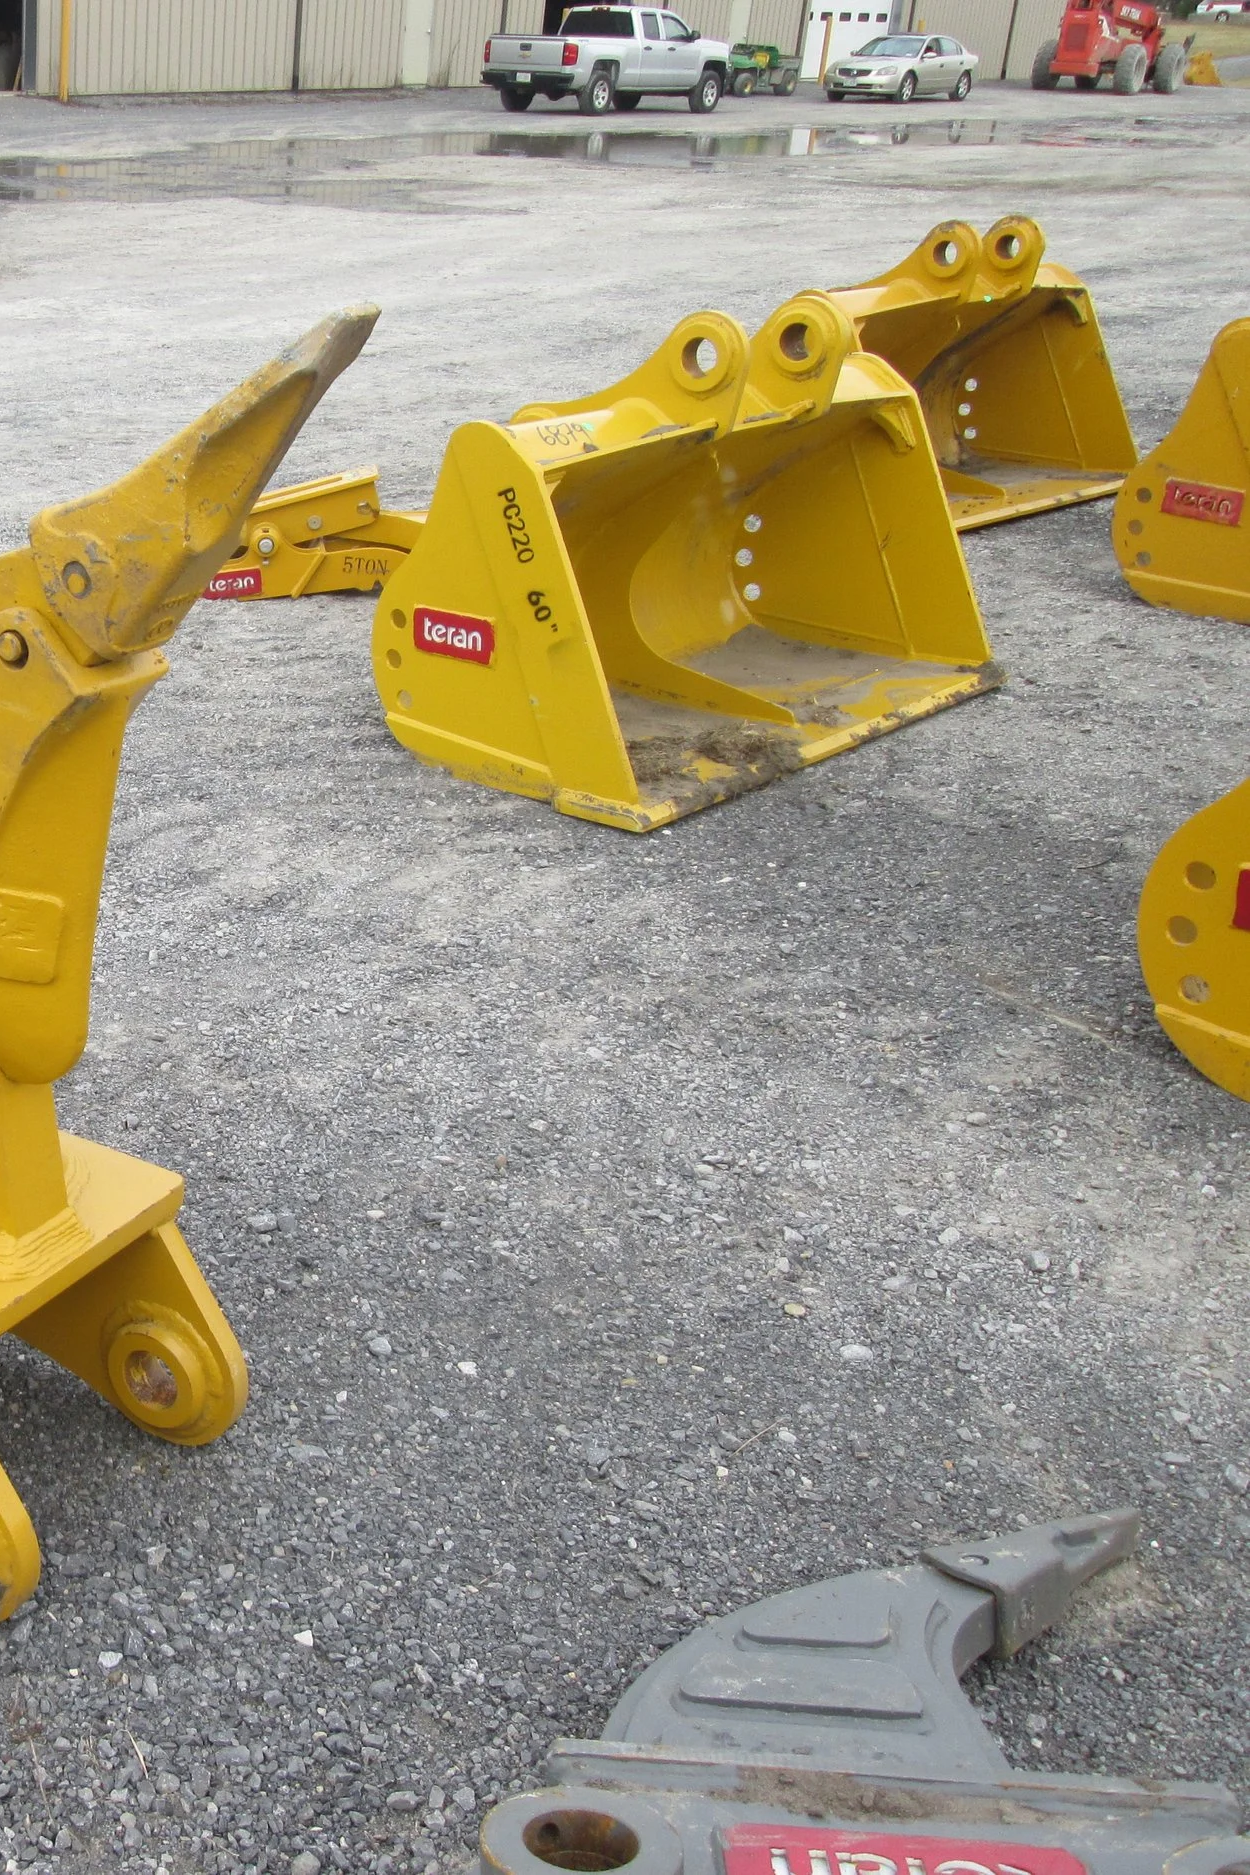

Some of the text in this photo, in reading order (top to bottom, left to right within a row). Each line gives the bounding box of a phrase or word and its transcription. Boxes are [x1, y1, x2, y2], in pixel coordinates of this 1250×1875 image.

[498, 487, 535, 564] PC220
[342, 556, 388, 576] 5TON
[209, 576, 254, 592] teran
[423, 617, 482, 651] teran
